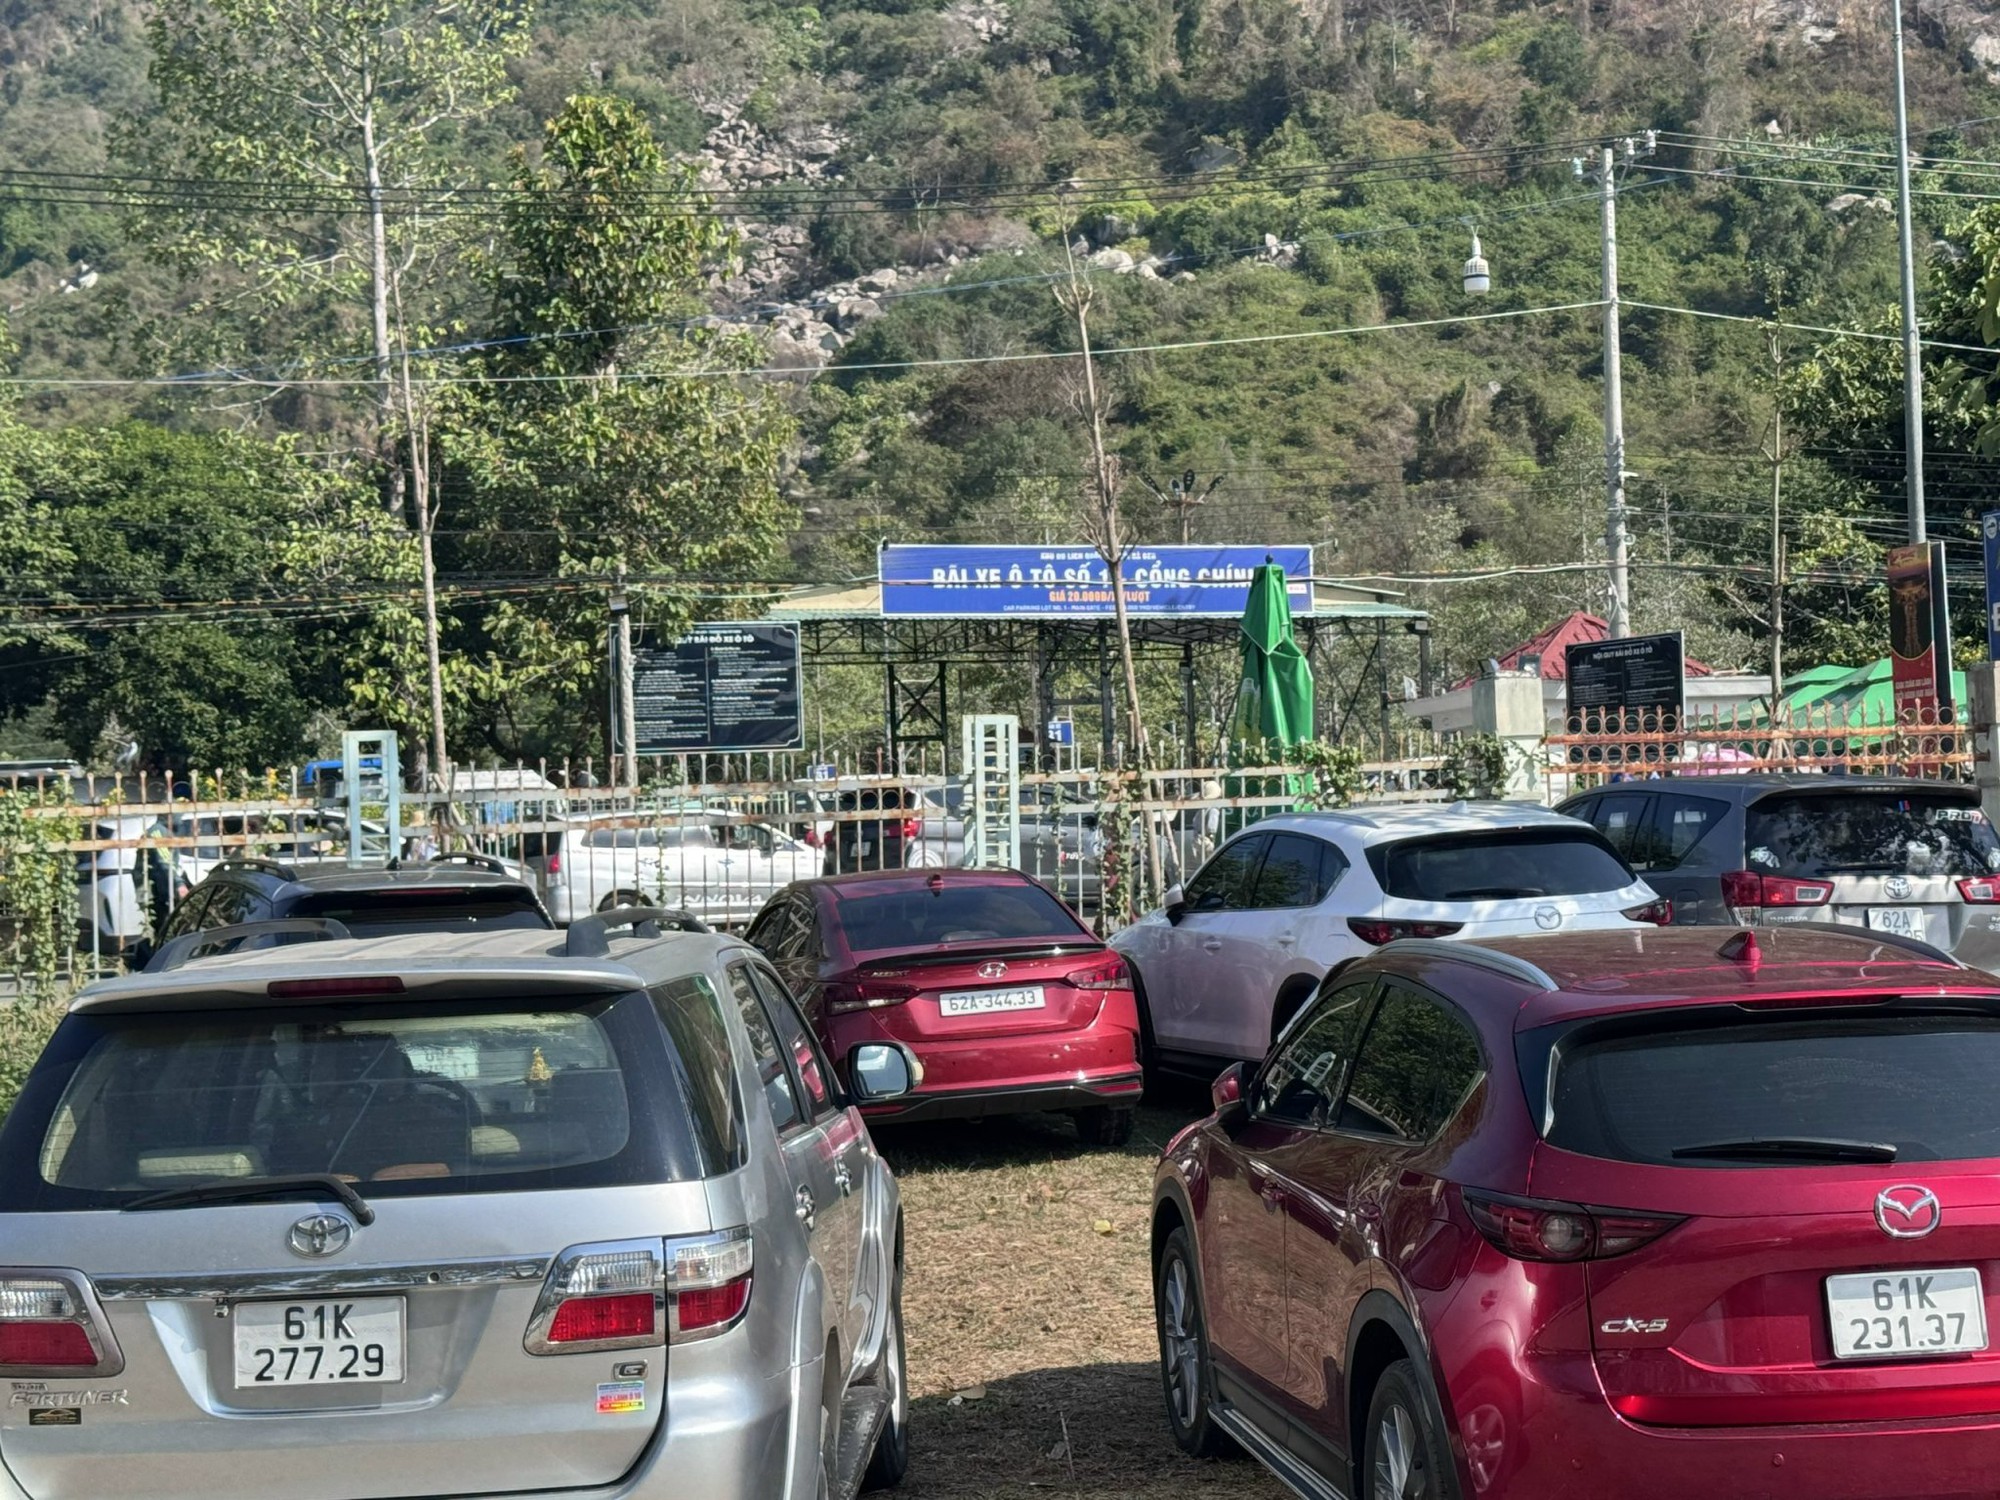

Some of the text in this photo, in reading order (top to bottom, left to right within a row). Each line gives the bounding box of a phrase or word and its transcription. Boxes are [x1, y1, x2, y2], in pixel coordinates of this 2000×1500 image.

[933, 564, 968, 588] BÃI
[975, 568, 1001, 588] XE
[1009, 563, 1022, 588] Ô
[1029, 563, 1056, 588] TÔ
[1064, 562, 1091, 588] SỐ
[1099, 569, 1109, 588] 1
[1135, 560, 1191, 588] CỔNG
[1049, 590, 1066, 602] GIÁ
[1882, 910, 1911, 929] 62A
[950, 990, 1036, 1012] 62A-344.33
[1872, 1276, 1937, 1311] 61K
[284, 1304, 356, 1340] 61K
[1600, 1318, 1670, 1334] CX-5
[1850, 1312, 1966, 1350] 231.37
[254, 1343, 384, 1382] 277.29
[9, 1389, 129, 1407] FORTUNER
